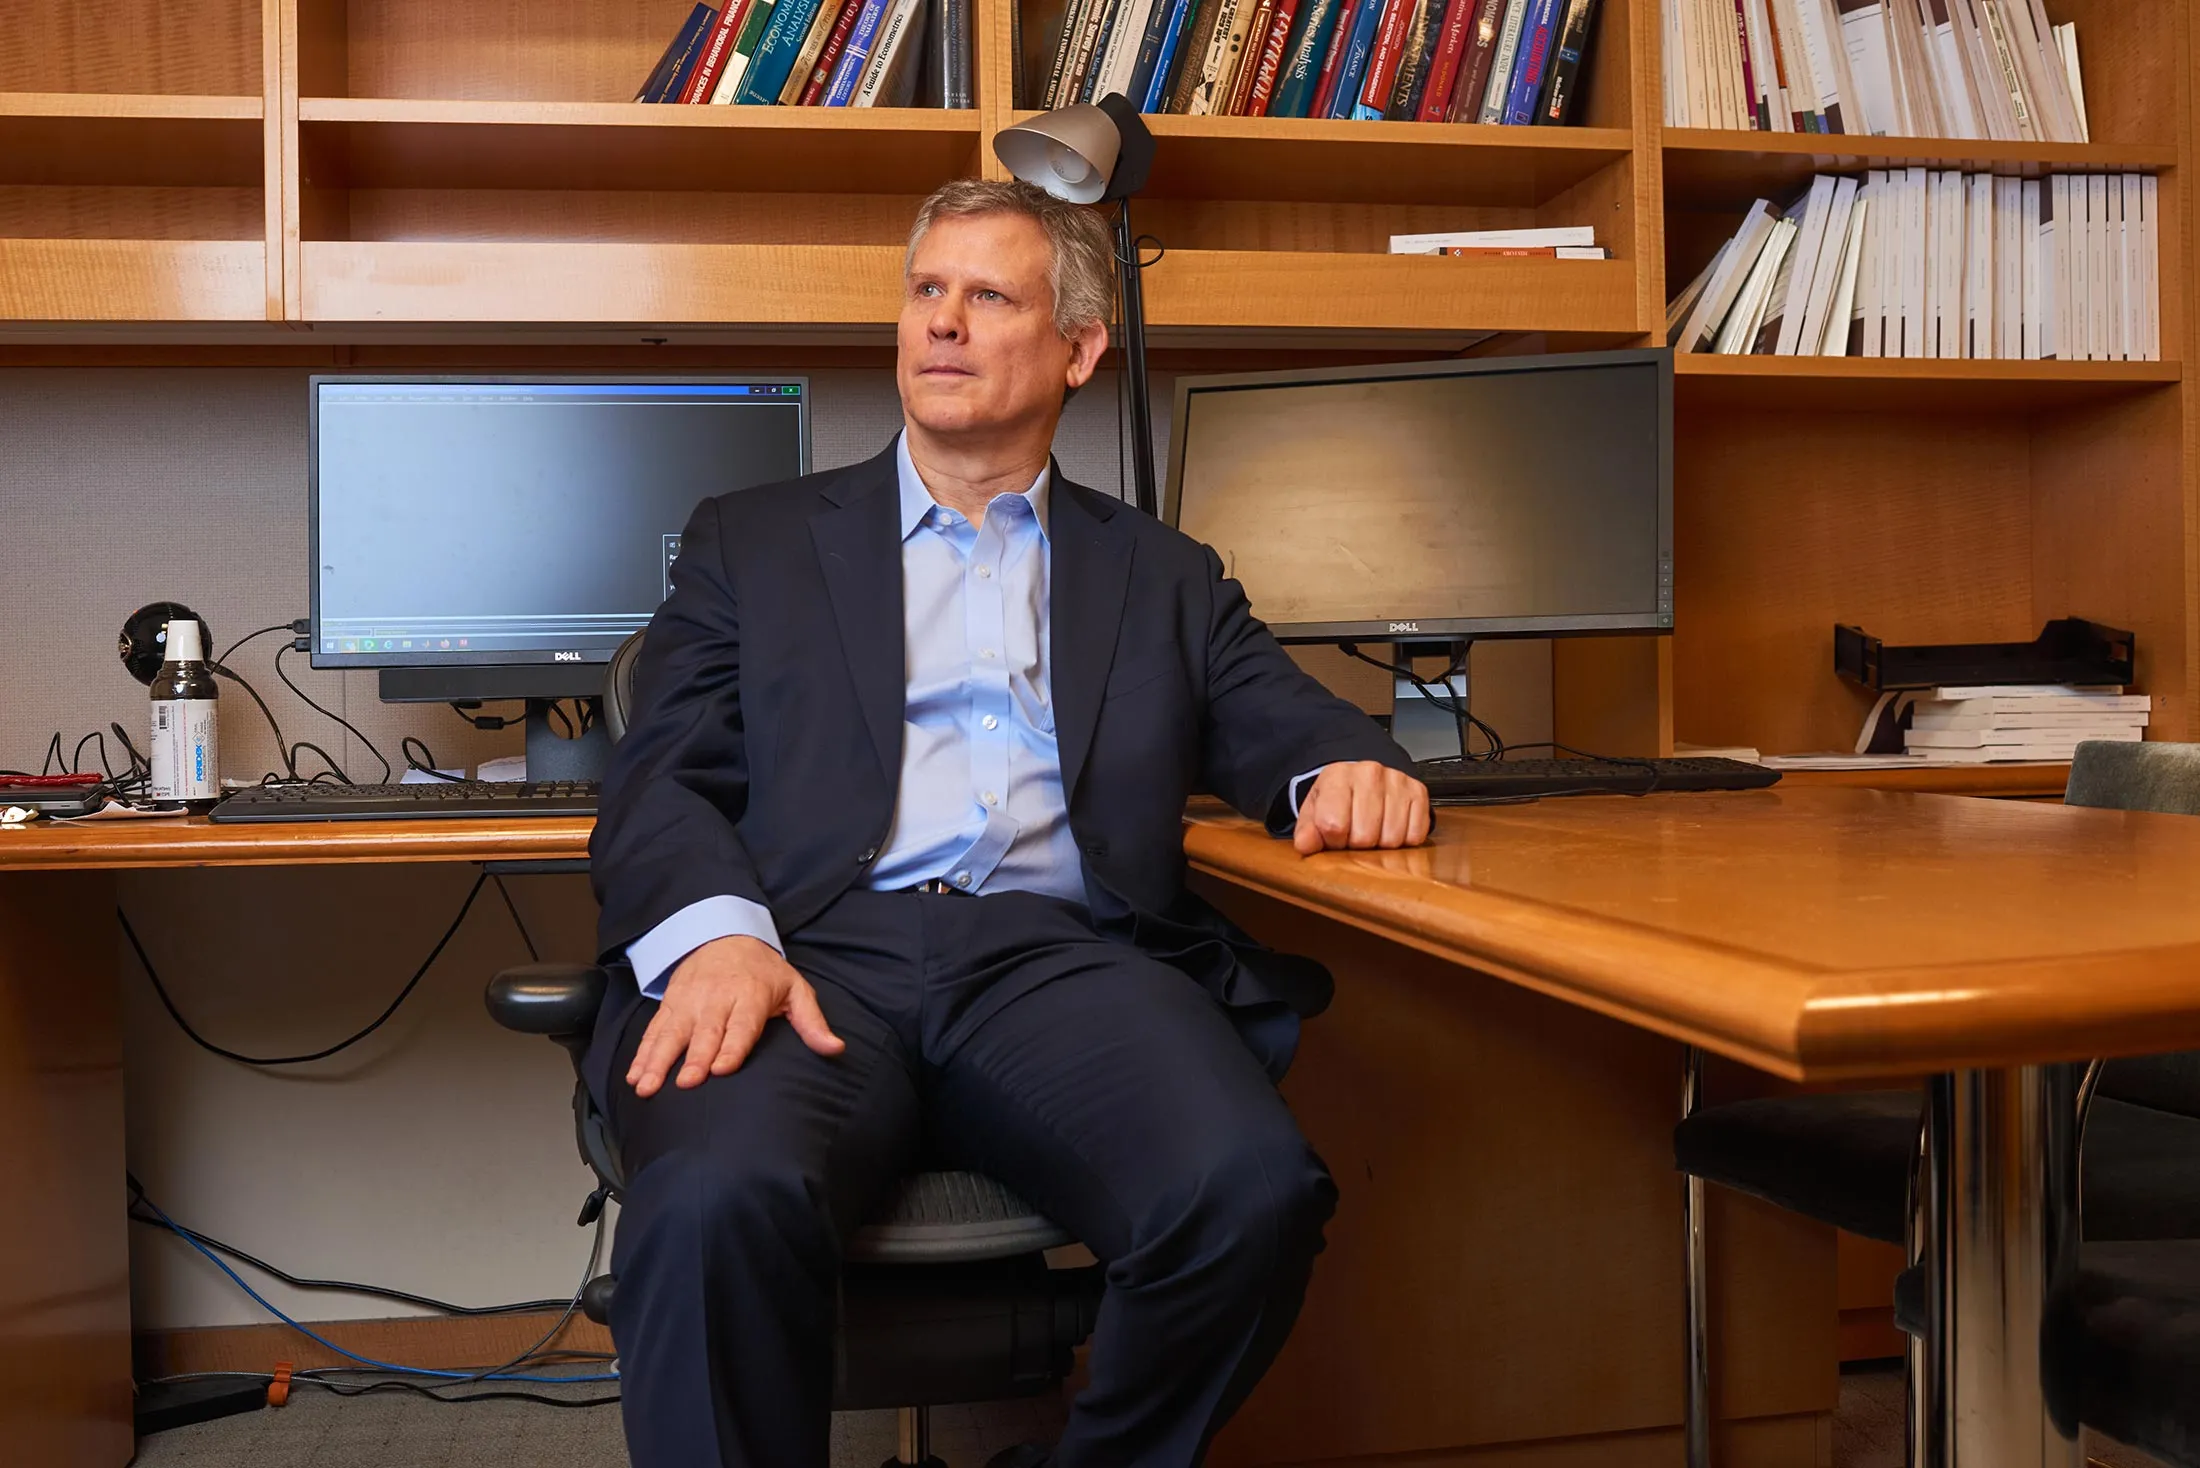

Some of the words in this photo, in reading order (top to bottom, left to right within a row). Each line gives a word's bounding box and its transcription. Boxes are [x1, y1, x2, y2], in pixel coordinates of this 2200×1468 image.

[839, 2, 859, 30] Play
[1117, 5, 1128, 28] Monetary
[1220, 6, 1237, 40] GREATEST
[1304, 5, 1325, 39] Series
[1383, 12, 1396, 46] SELECTION,
[705, 26, 730, 68] BEHAVIORAL
[881, 13, 904, 61] Econometrics
[1063, 29, 1070, 37] IN
[1081, 22, 1097, 52] Survey
[1393, 20, 1405, 50] JOHNSON
[1445, 21, 1461, 55] Markets
[1502, 14, 1519, 52] LITERATURE
[801, 39, 818, 70] FUTURES
[876, 60, 883, 70] to
[1052, 38, 1067, 76] INDUSTRIAL
[1253, 9, 1291, 101] TOPOLOGY
[1295, 37, 1315, 79] Analysis
[1349, 40, 1365, 78] FINANCE
[1379, 47, 1388, 60] AND
[1397, 14, 1431, 107] INVESTMENTS
[1497, 53, 1509, 74] INDEX
[1524, 24, 1549, 85] ACCOUNTING
[702, 66, 712, 76] IN
[866, 69, 880, 90] Guide
[1170, 53, 1198, 112] Dynamics
[1368, 60, 1383, 104] MANAGEMENT
[863, 89, 871, 97] A
[1045, 80, 1057, 107] AMERICA
[1389, 622, 1419, 633] DELL
[554, 652, 581, 661] DELL
